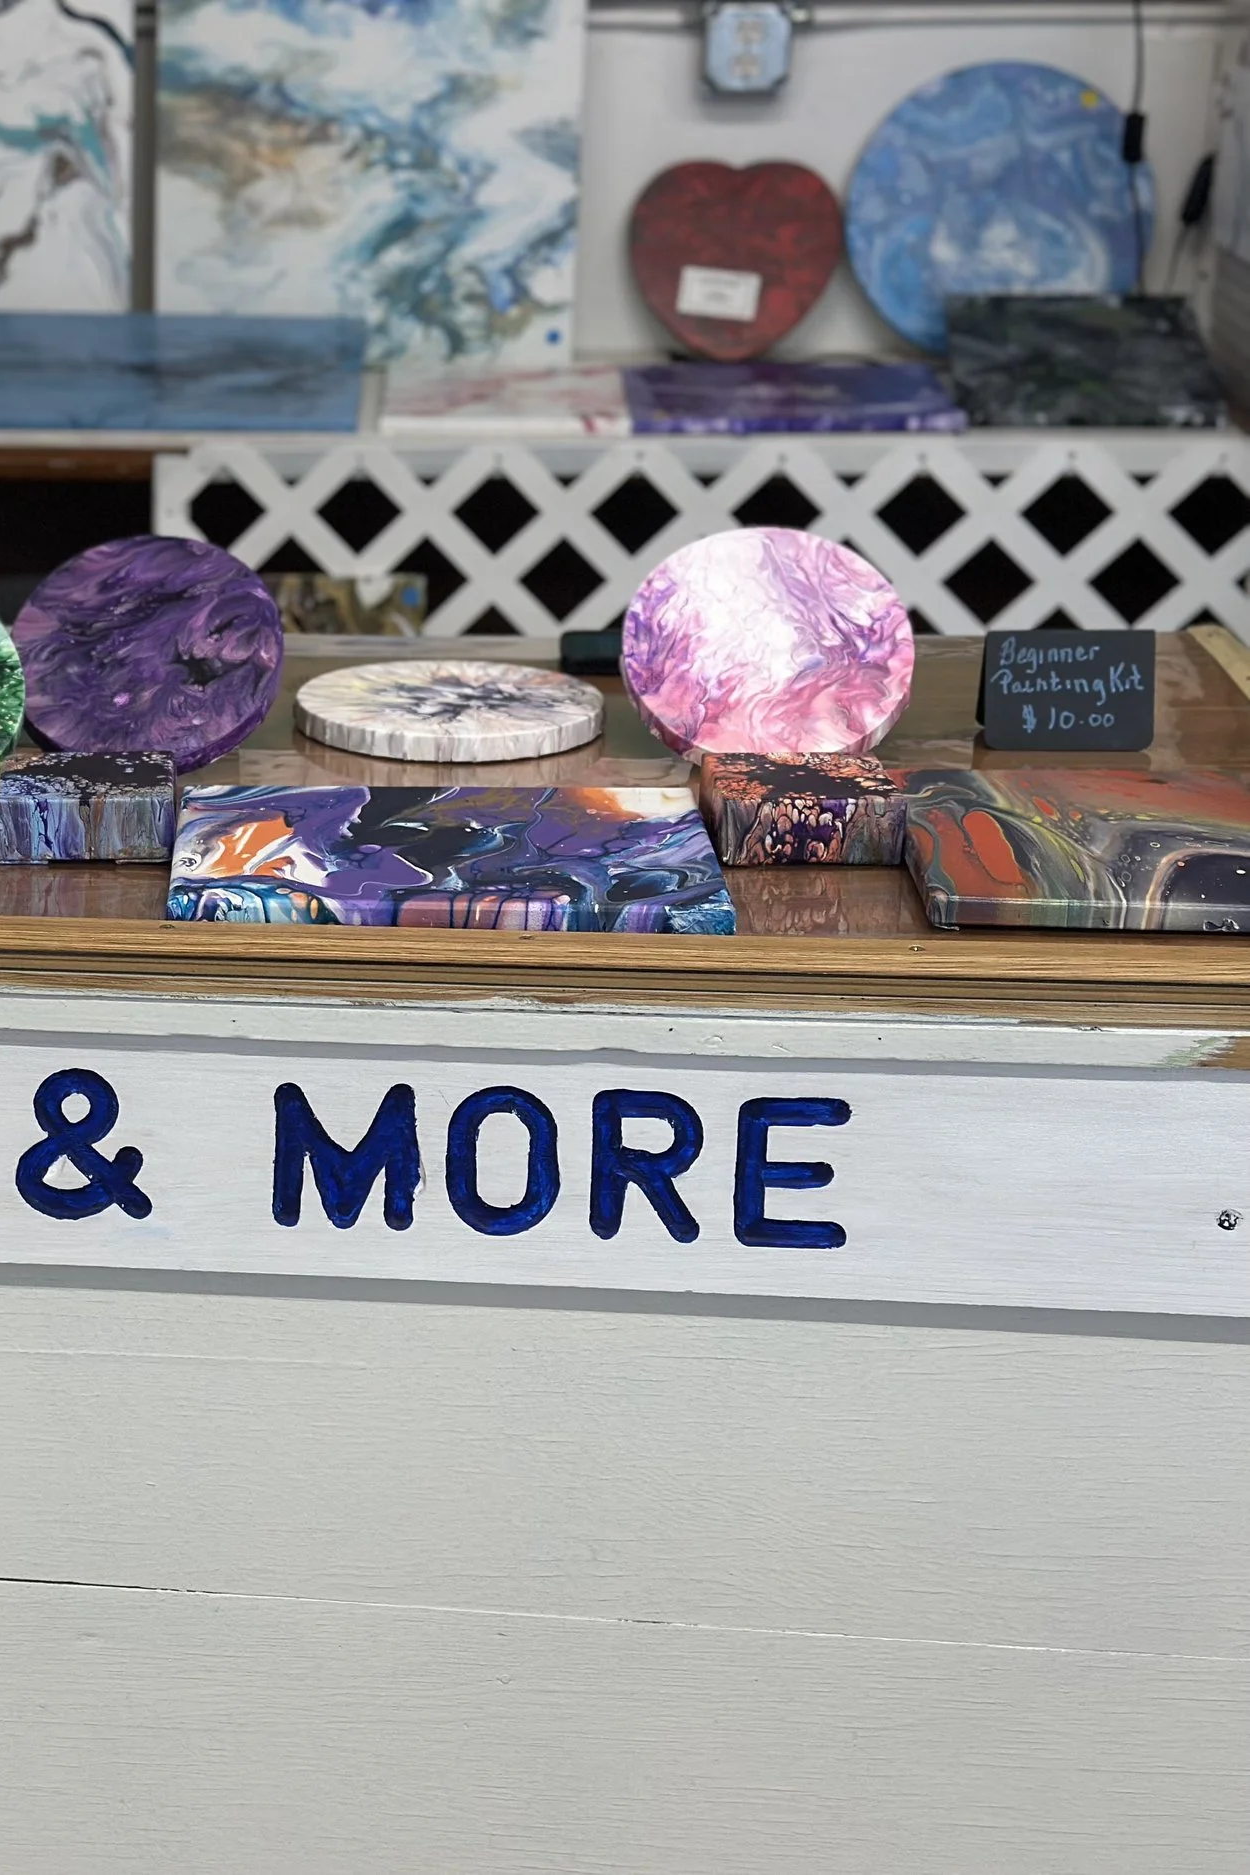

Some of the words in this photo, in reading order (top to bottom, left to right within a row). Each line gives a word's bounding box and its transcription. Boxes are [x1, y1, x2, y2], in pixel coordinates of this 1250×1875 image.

[999, 636, 1100, 674] Beginner
[990, 668, 1107, 706] Painting
[1109, 661, 1145, 693] Kit
[15, 1067, 153, 1220] &
[273, 1082, 853, 1249] MORE
